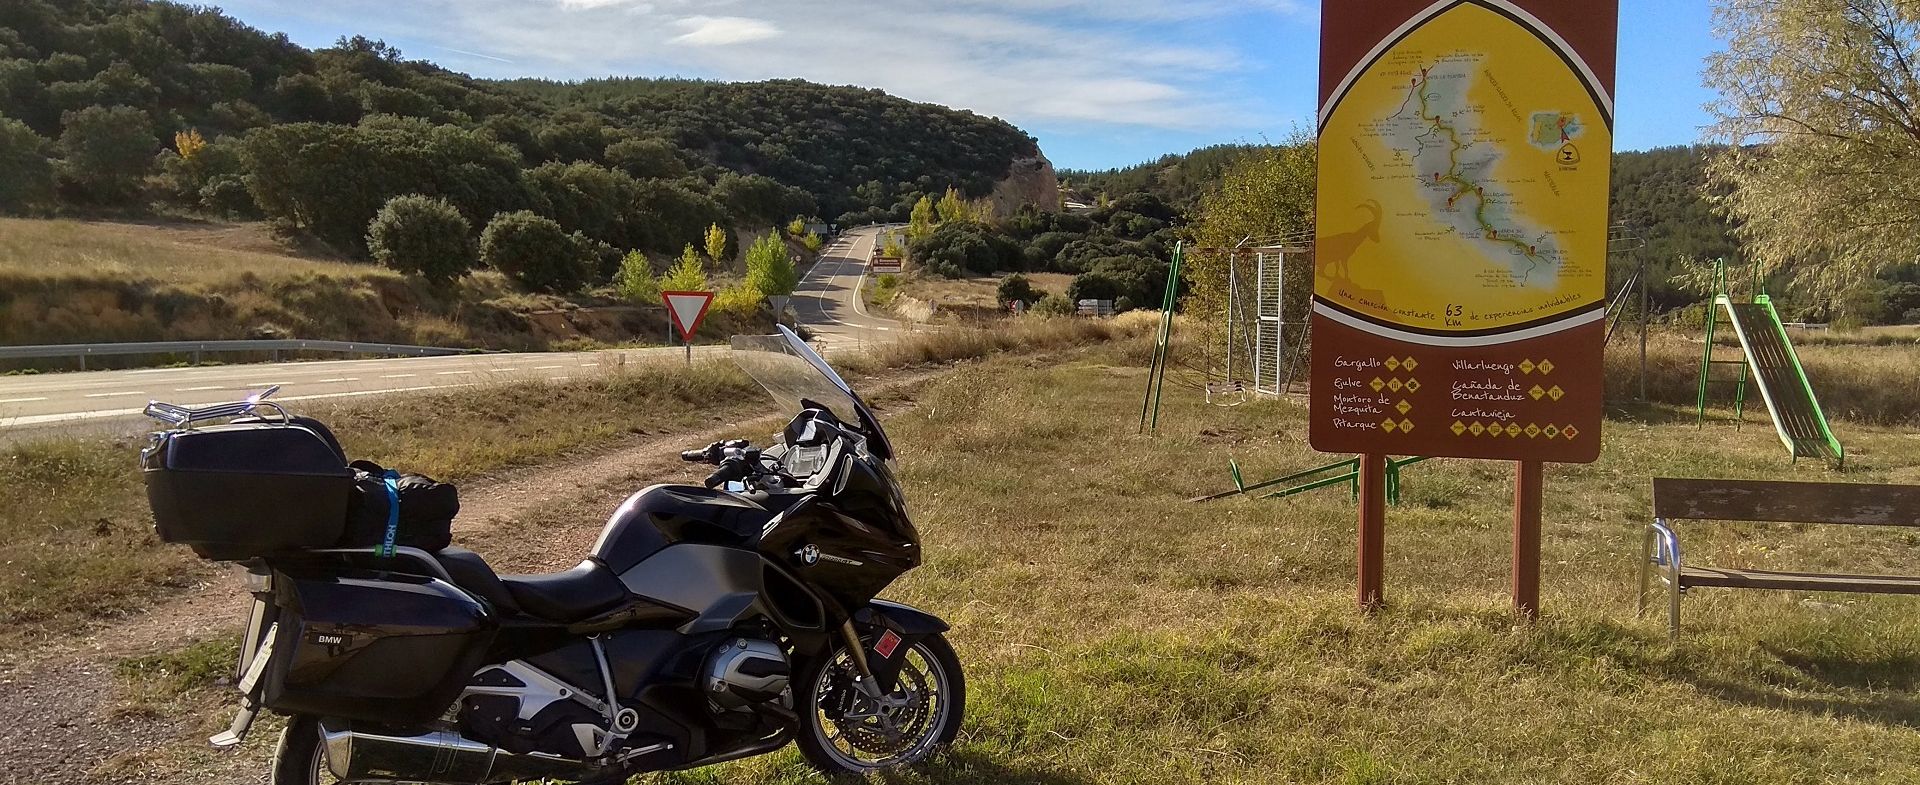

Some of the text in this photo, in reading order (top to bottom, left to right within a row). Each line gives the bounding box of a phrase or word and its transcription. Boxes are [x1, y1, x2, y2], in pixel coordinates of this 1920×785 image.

[1338, 289, 1354, 300] Una
[1393, 308, 1436, 320] constante
[1445, 303, 1463, 317] 63
[1469, 293, 1581, 321] de experiencias inolvidables
[1334, 355, 1381, 371] Gargallo
[1452, 360, 1514, 374] Villarluengo
[1334, 377, 1362, 389] Ejulve
[1451, 378, 1521, 391] Cañada de
[1333, 393, 1390, 405] Montoro de
[1450, 389, 1525, 401] Benatanduz
[1333, 403, 1382, 416] Mezquita
[1451, 408, 1515, 421] Cantavieja
[1332, 417, 1377, 431] Pitarque
[318, 635, 342, 644] BMW
